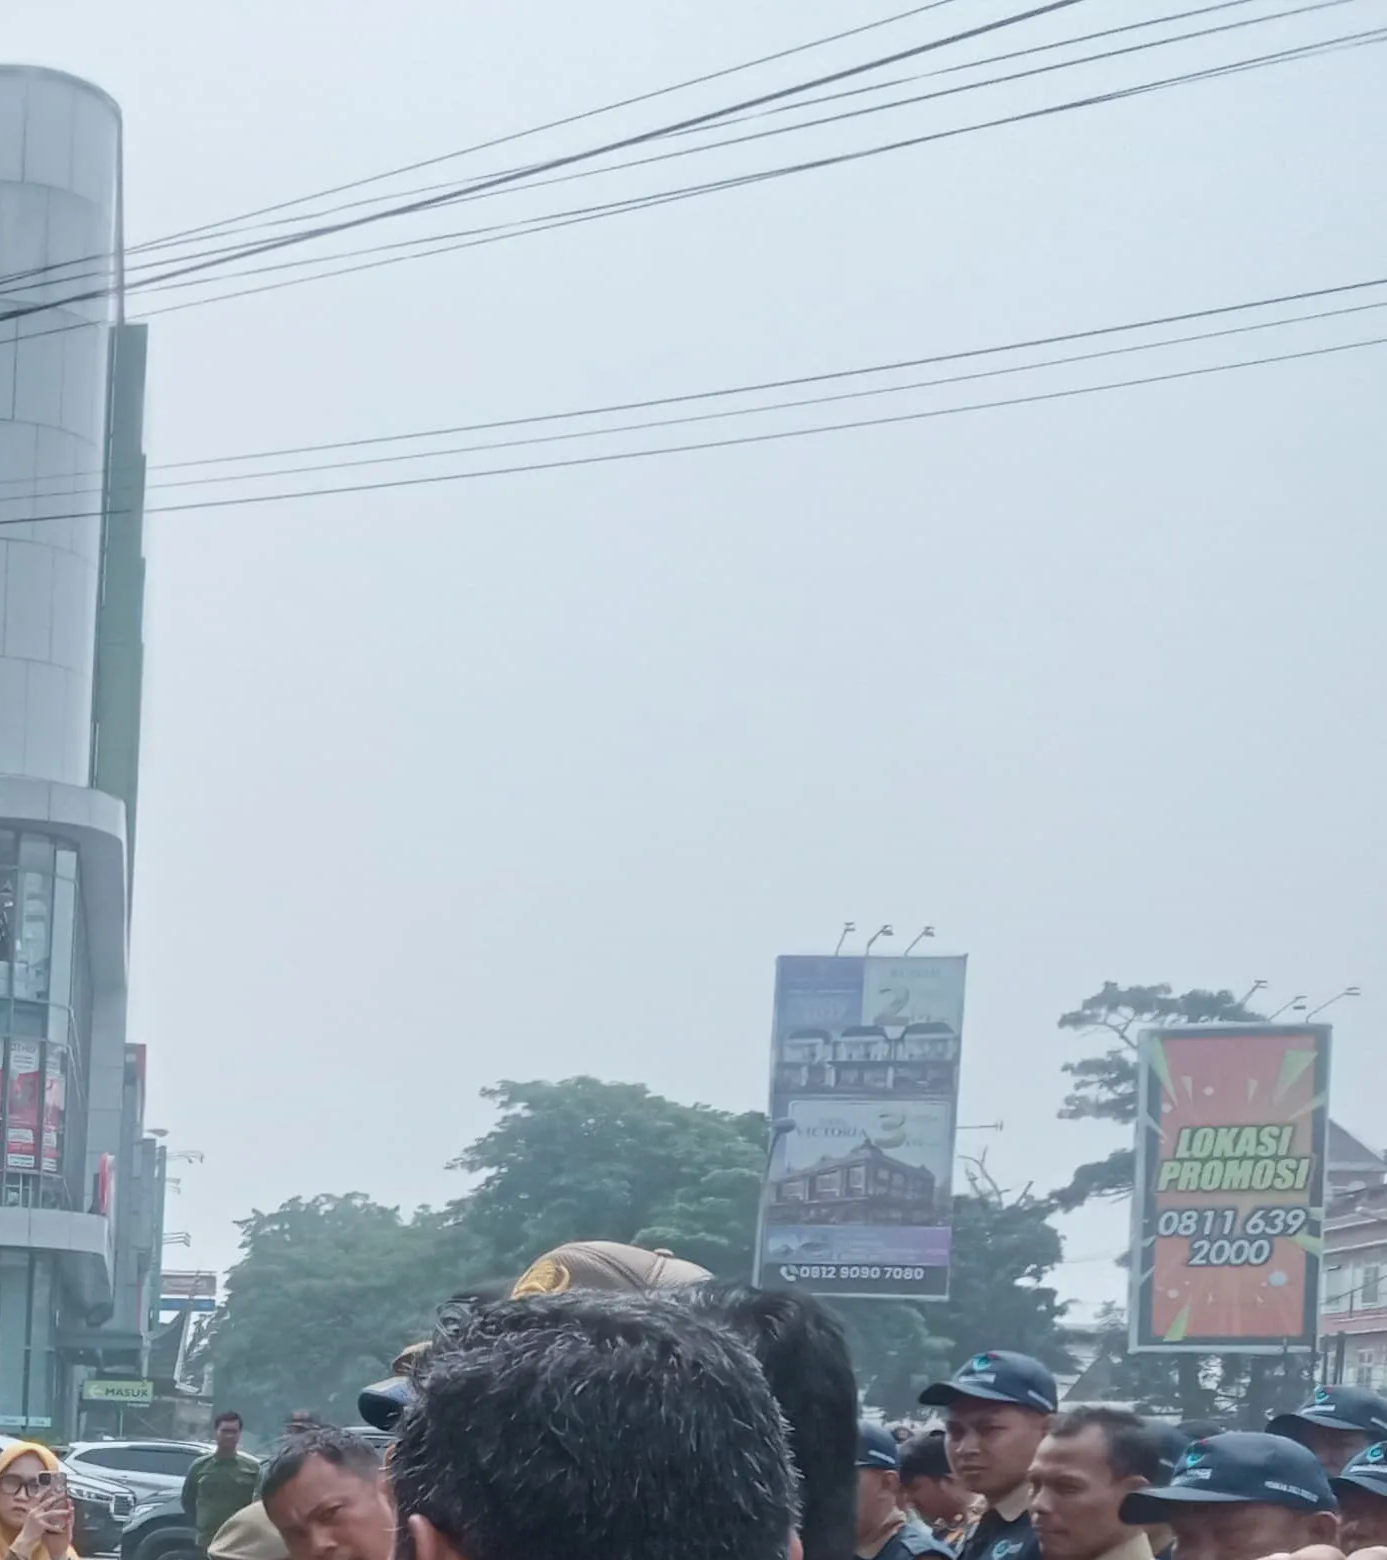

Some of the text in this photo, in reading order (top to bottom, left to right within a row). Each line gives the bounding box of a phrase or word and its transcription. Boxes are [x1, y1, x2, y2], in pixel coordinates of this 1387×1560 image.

[1175, 1125, 1294, 1159] LOKASI
[1157, 1158, 1311, 1192] PROMOSI
[1158, 1207, 1307, 1237] 0811 639
[1186, 1238, 1272, 1267] 2000
[799, 1266, 836, 1279] 0812
[104, 1386, 148, 1398] MASUK
